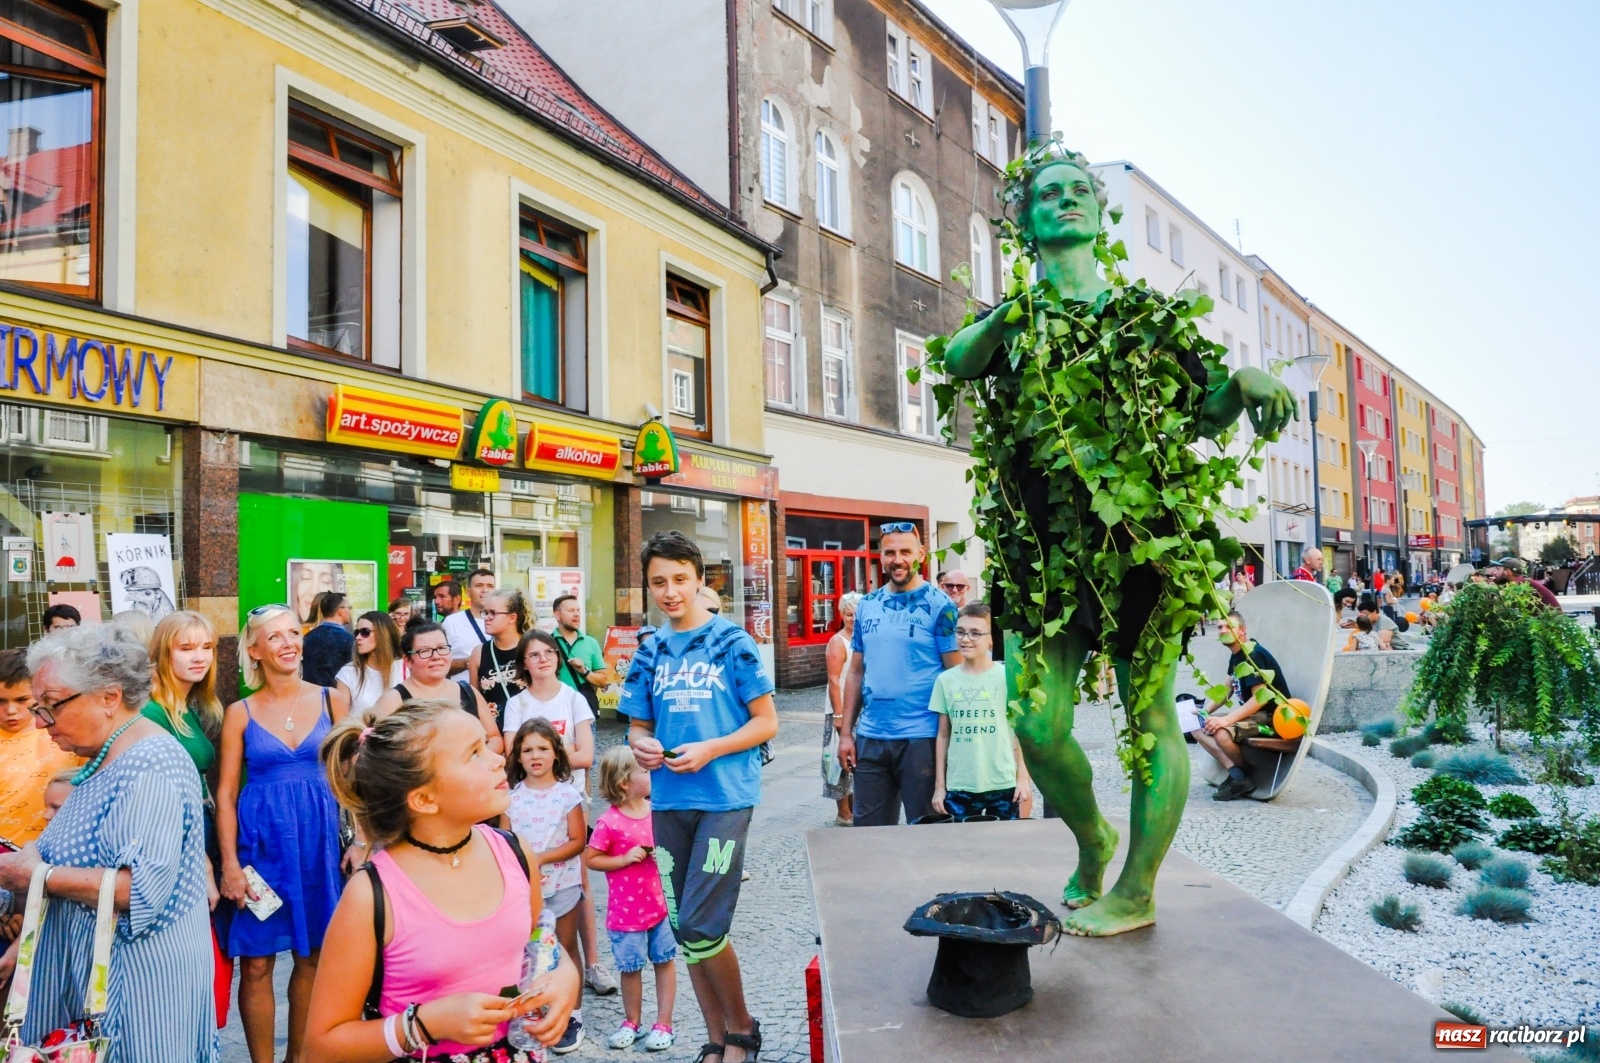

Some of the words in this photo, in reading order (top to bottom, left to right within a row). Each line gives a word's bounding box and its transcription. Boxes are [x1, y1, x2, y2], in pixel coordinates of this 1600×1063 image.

[340, 413, 459, 442] art.spożywcze
[481, 447, 514, 461] żabka
[555, 446, 602, 465] alkohol
[635, 462, 670, 474] żabka
[691, 454, 731, 474] MARMARA
[458, 467, 497, 479] OTWARTE
[468, 480, 474, 488] 6
[480, 480, 485, 489] 2
[711, 474, 737, 489] KEBAB
[653, 657, 726, 697] BLACK
[952, 709, 996, 719] STREETS
[702, 837, 735, 875] M
